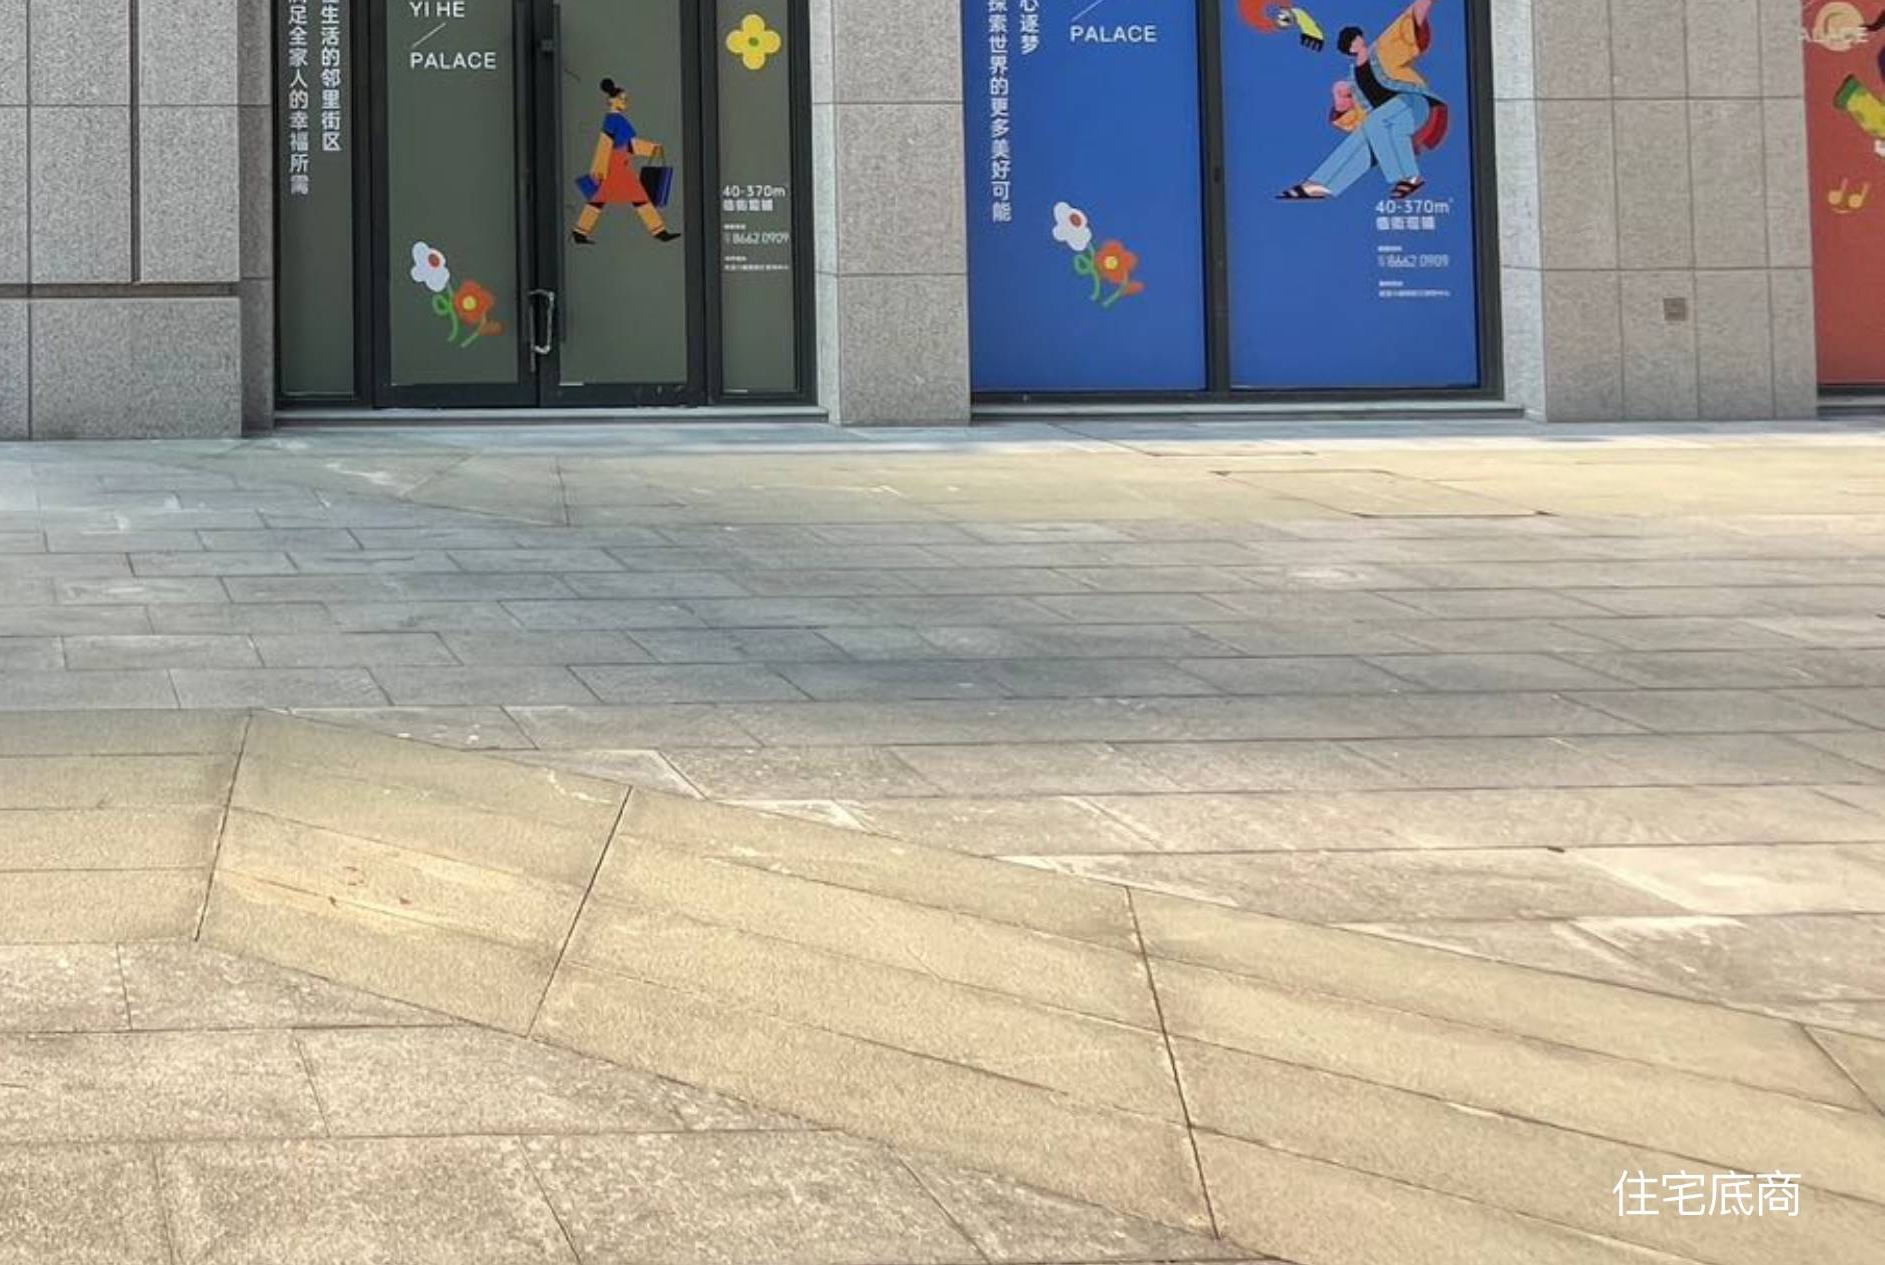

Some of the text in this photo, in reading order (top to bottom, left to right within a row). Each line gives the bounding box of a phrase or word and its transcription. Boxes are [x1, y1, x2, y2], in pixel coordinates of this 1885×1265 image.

[409, 0, 466, 18] YI HE
[1070, 24, 1157, 43] PALACE
[410, 51, 497, 70] PALACE
